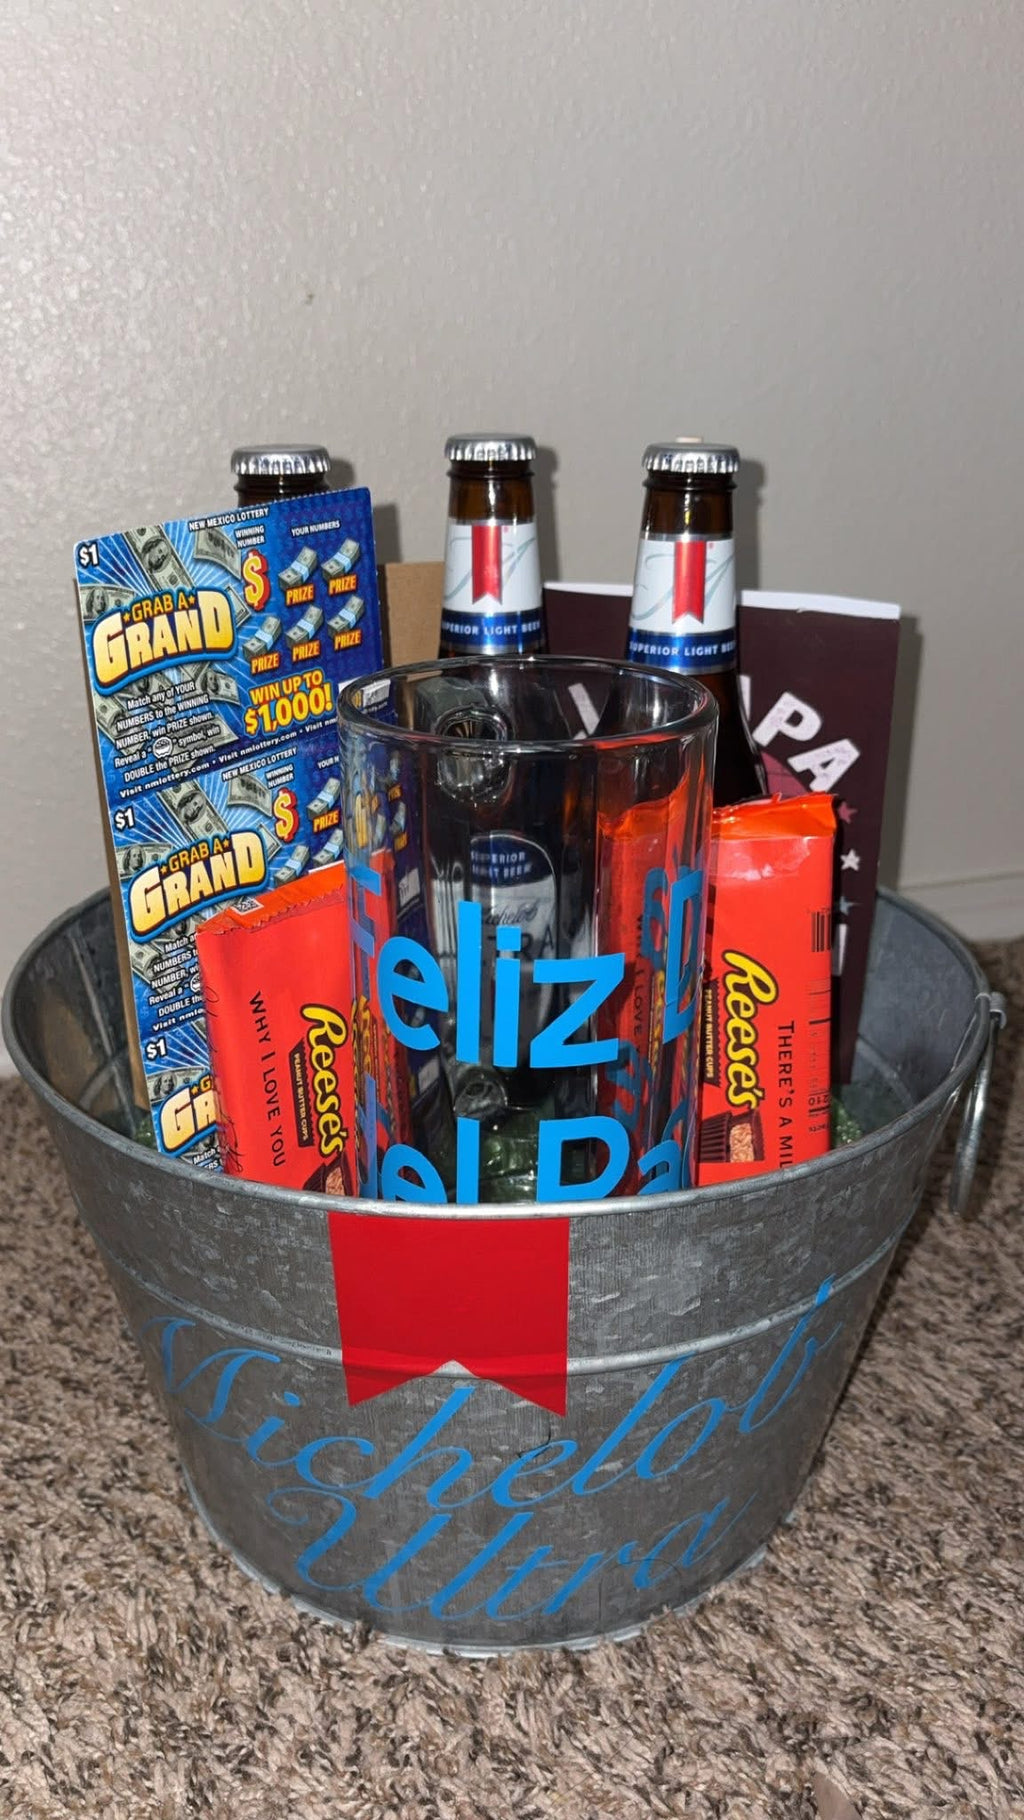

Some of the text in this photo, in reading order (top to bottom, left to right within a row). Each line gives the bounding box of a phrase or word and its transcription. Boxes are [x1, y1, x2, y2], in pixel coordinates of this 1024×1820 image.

[189, 508, 269, 531] NEW MEXICO LOTTERY
[291, 520, 341, 537] YOUR NUMBERS
[235, 525, 265, 538] WINNING
[237, 536, 265, 548] NUMBER
[79, 544, 99, 566] $1
[286, 584, 314, 606] PRIZE
[329, 574, 357, 595] PRIZE
[132, 592, 188, 622] GRAB A
[93, 590, 234, 685] GRAND
[334, 629, 362, 650] PRIZE
[484, 624, 518, 635] LIGHT
[292, 640, 320, 663] PRIZE
[684, 644, 718, 656] LIGHT
[252, 652, 280, 675] PRIZE
[127, 682, 195, 709] Match any of YOUR
[250, 670, 323, 705] WIN UP TO
[117, 694, 209, 731] NUMBERS to the WINNING
[244, 683, 333, 735] $1,000!
[152, 726, 166, 738] win
[167, 720, 188, 733] PRIZE
[115, 752, 140, 767] Reveal
[207, 726, 220, 737] win
[120, 786, 143, 798] Visit
[144, 763, 210, 789] nmlottery.com
[218, 751, 239, 763] Visit
[240, 731, 297, 755] nmlottery.com
[305, 721, 323, 733] Visit
[125, 764, 154, 782] DOUBLE
[155, 759, 168, 771] the
[168, 753, 189, 766] PRIZE
[222, 747, 297, 781] NEW MEXICO LOTTERY
[317, 758, 333, 769] YOUR
[265, 764, 294, 779] WINNING
[268, 773, 294, 788] NUMBER
[115, 808, 134, 830] $1
[313, 810, 340, 833] PRIZE
[169, 838, 224, 872] GRAB A
[130, 831, 265, 933] GRAND
[165, 937, 188, 952] Match
[153, 951, 191, 972] NUMBERS
[149, 988, 176, 1005] Reveal
[158, 997, 191, 1016] DOUBLE
[153, 1018, 176, 1031] Visit
[704, 988, 714, 1078] PEANUT BUTTER CUPS
[722, 949, 779, 1110] Reese's
[146, 1039, 166, 1060] $1
[777, 1020, 796, 1108] THERE'S
[250, 991, 286, 1167] WHY I LOVE YOU
[300, 1004, 349, 1158] Reese's
[293, 1052, 309, 1141] PEANUT BUTTER CUPS
[778, 1116, 793, 1128] A
[193, 1148, 216, 1164] Match
[140, 1273, 843, 1509] Michelob
[266, 1487, 757, 1622] Ultra
